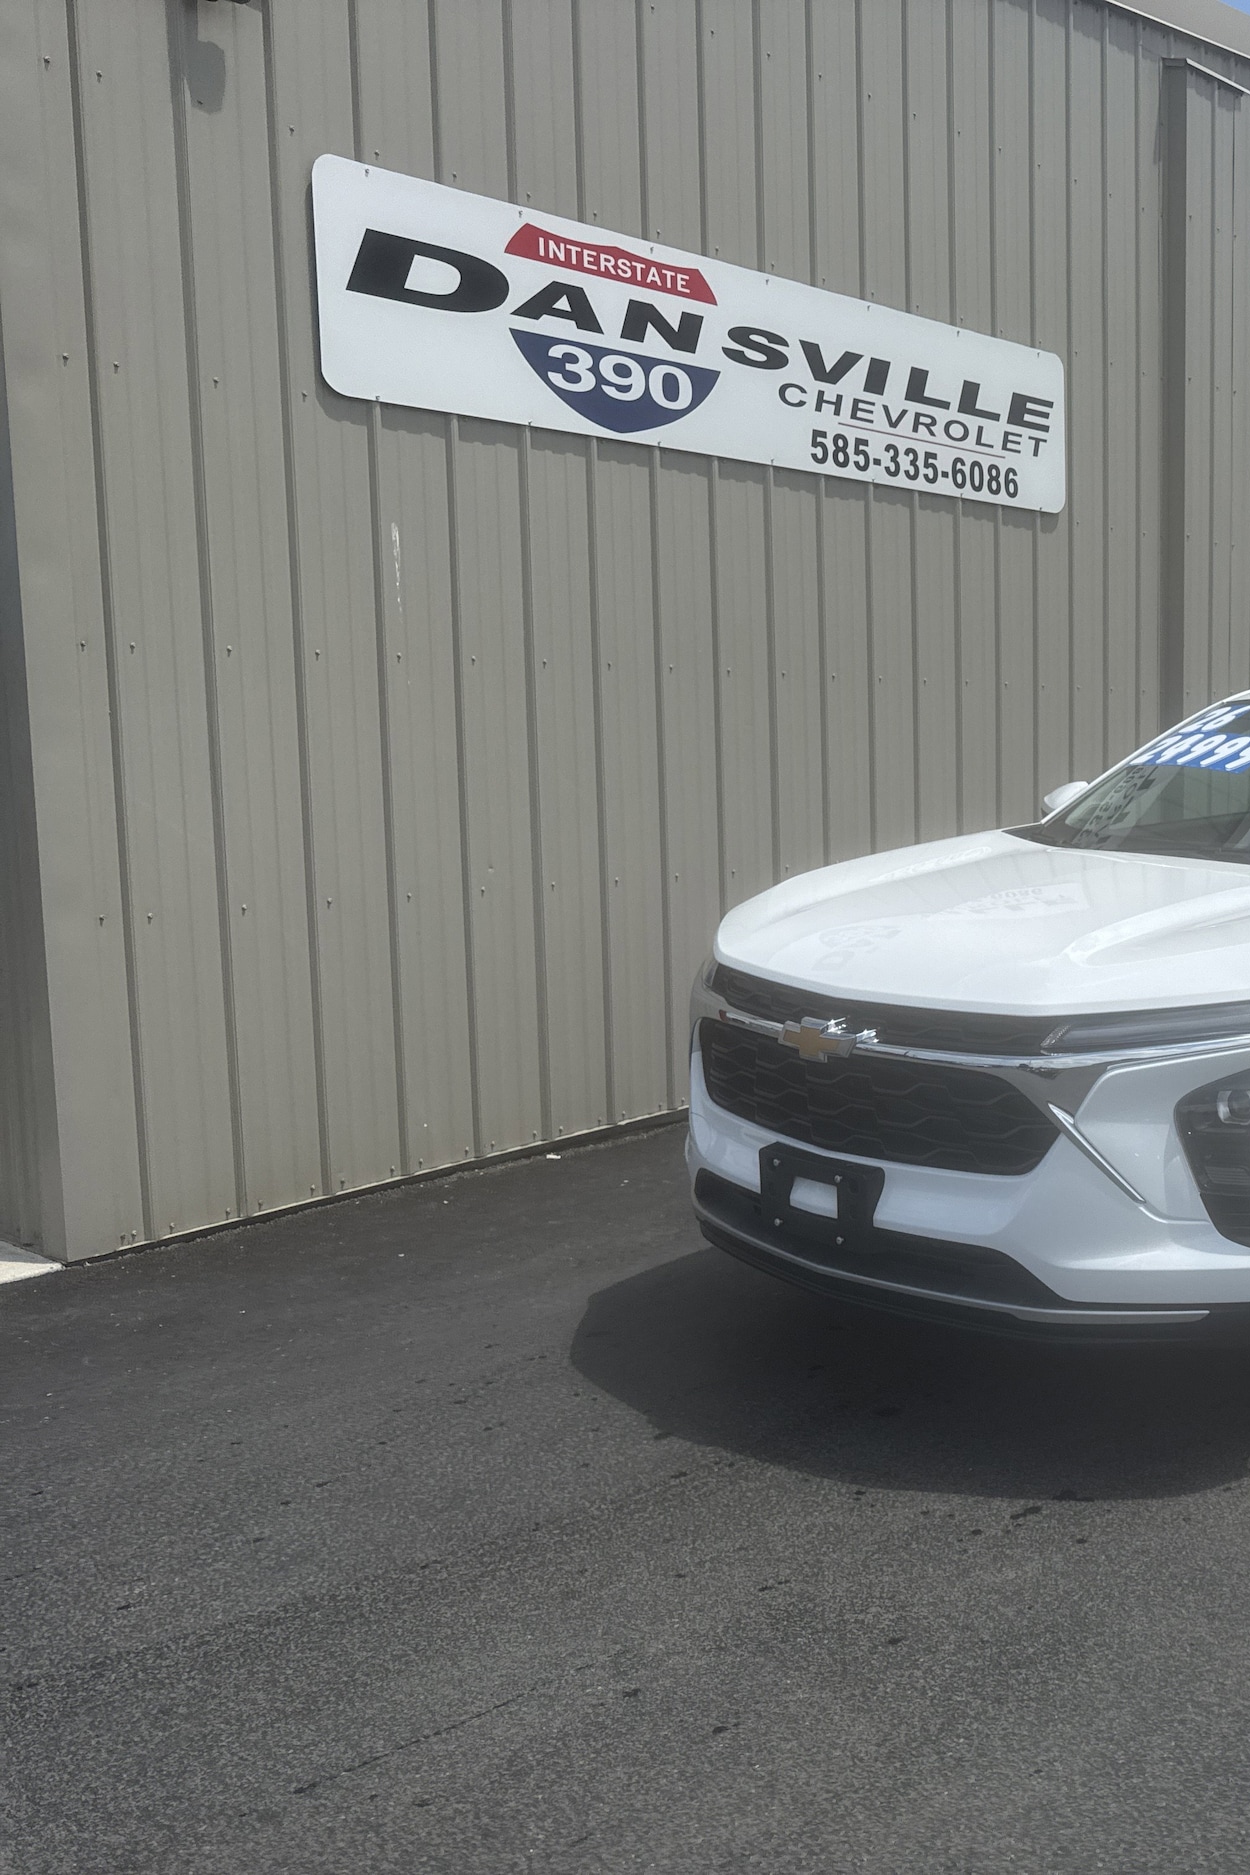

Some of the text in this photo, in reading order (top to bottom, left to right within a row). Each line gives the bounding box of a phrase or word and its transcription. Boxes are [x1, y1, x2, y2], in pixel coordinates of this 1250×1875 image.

[537, 235, 692, 295] INTERSTATE
[345, 227, 1055, 434] DANSVILLE
[546, 344, 694, 411] 390
[777, 382, 1048, 458] CHEVROLET
[810, 429, 1020, 497] 585-335-6086
